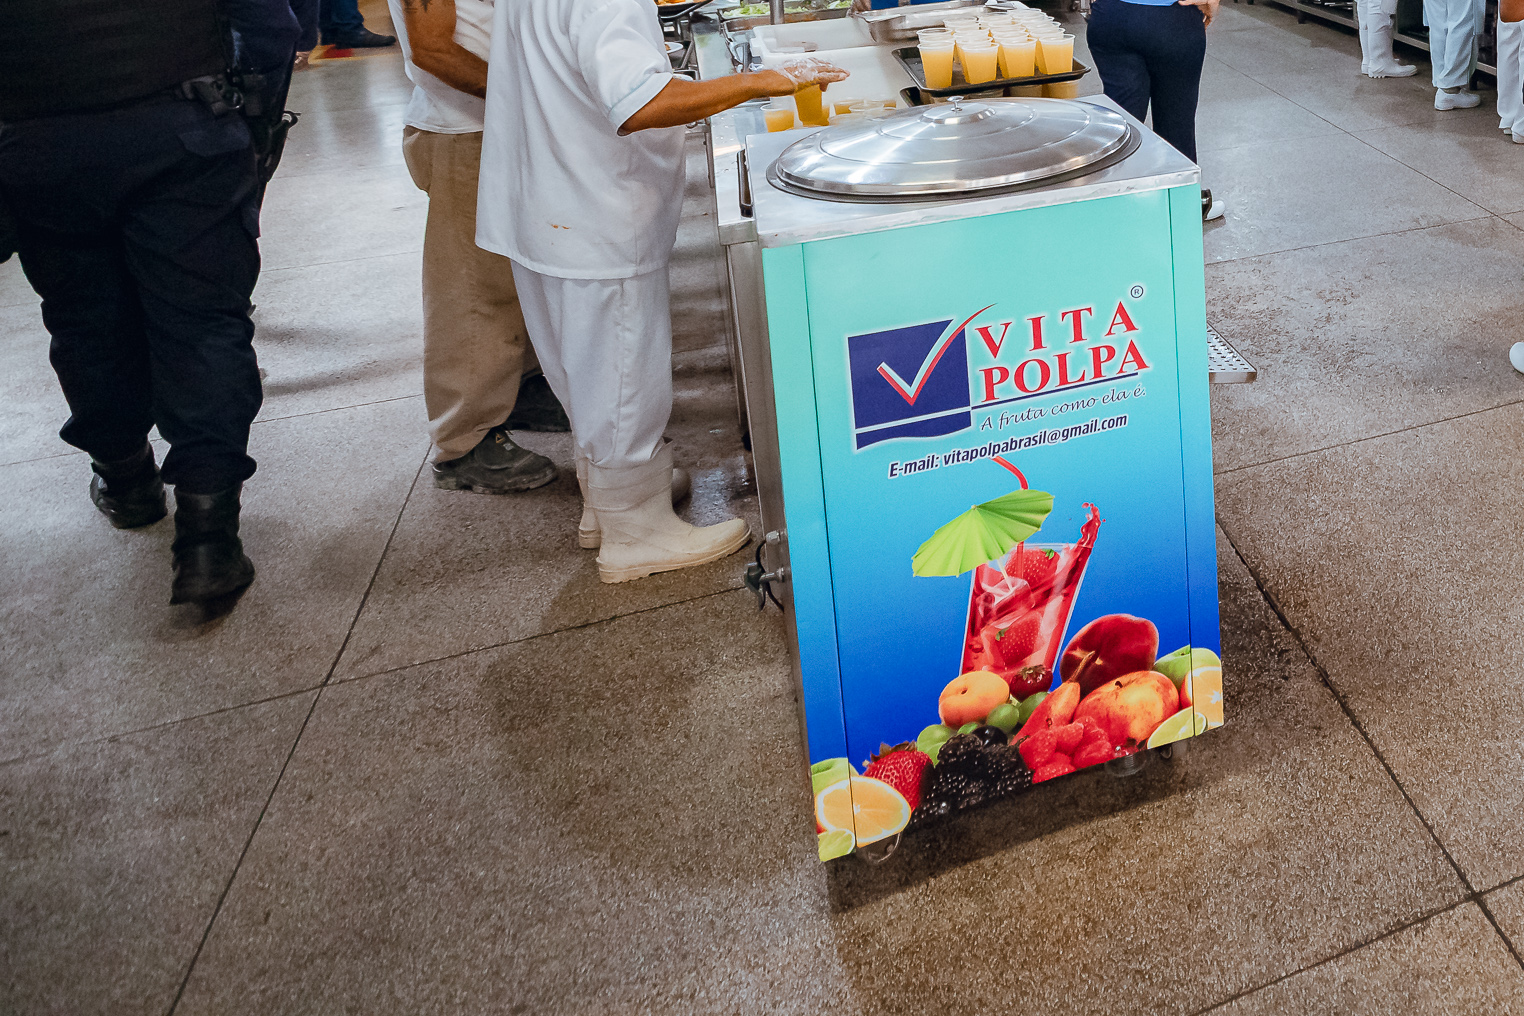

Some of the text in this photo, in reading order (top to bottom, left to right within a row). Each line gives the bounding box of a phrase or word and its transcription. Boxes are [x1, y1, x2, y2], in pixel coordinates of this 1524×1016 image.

[975, 301, 1139, 359] VITA
[979, 339, 1150, 402] POLPA
[980, 383, 1147, 430] A fruta como ela é.
[888, 413, 1128, 478] E-mail: vitapolpabrasil@gmail.com
